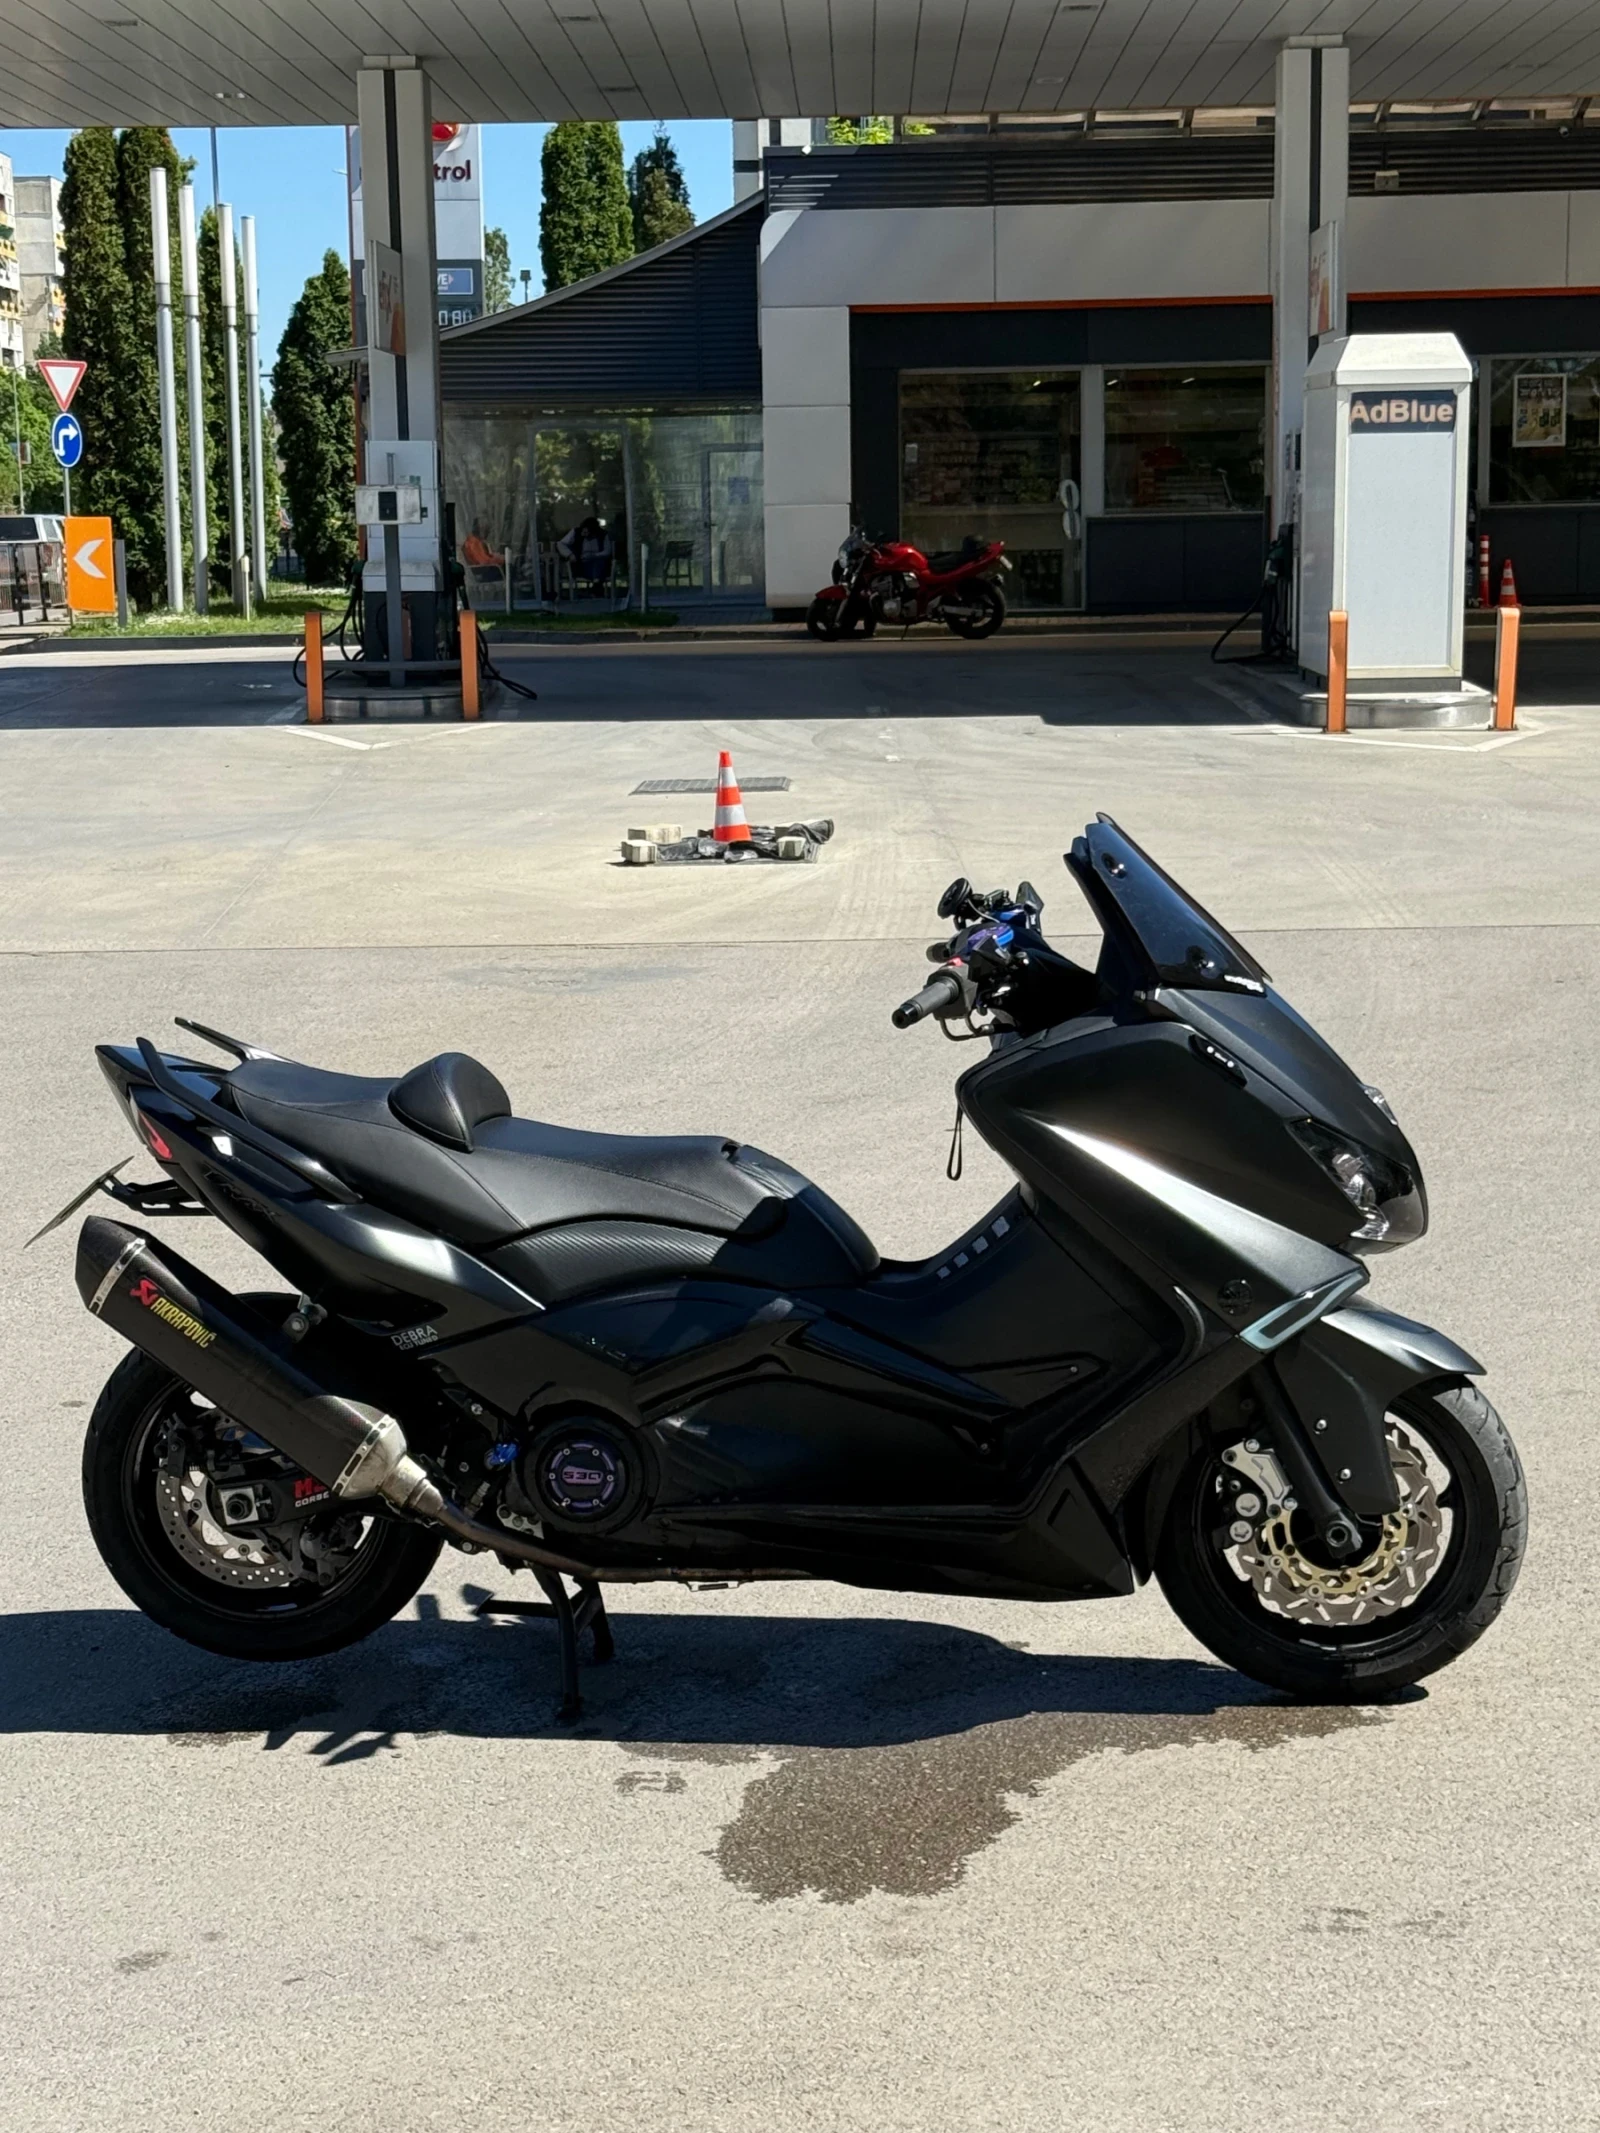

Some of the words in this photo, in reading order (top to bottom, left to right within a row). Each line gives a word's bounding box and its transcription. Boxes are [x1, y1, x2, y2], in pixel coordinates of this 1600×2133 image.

[433, 159, 472, 181] trol
[1349, 399, 1454, 423] AdBlue
[391, 1324, 438, 1346] DEBRA
[295, 1490, 330, 1508] CORSE
